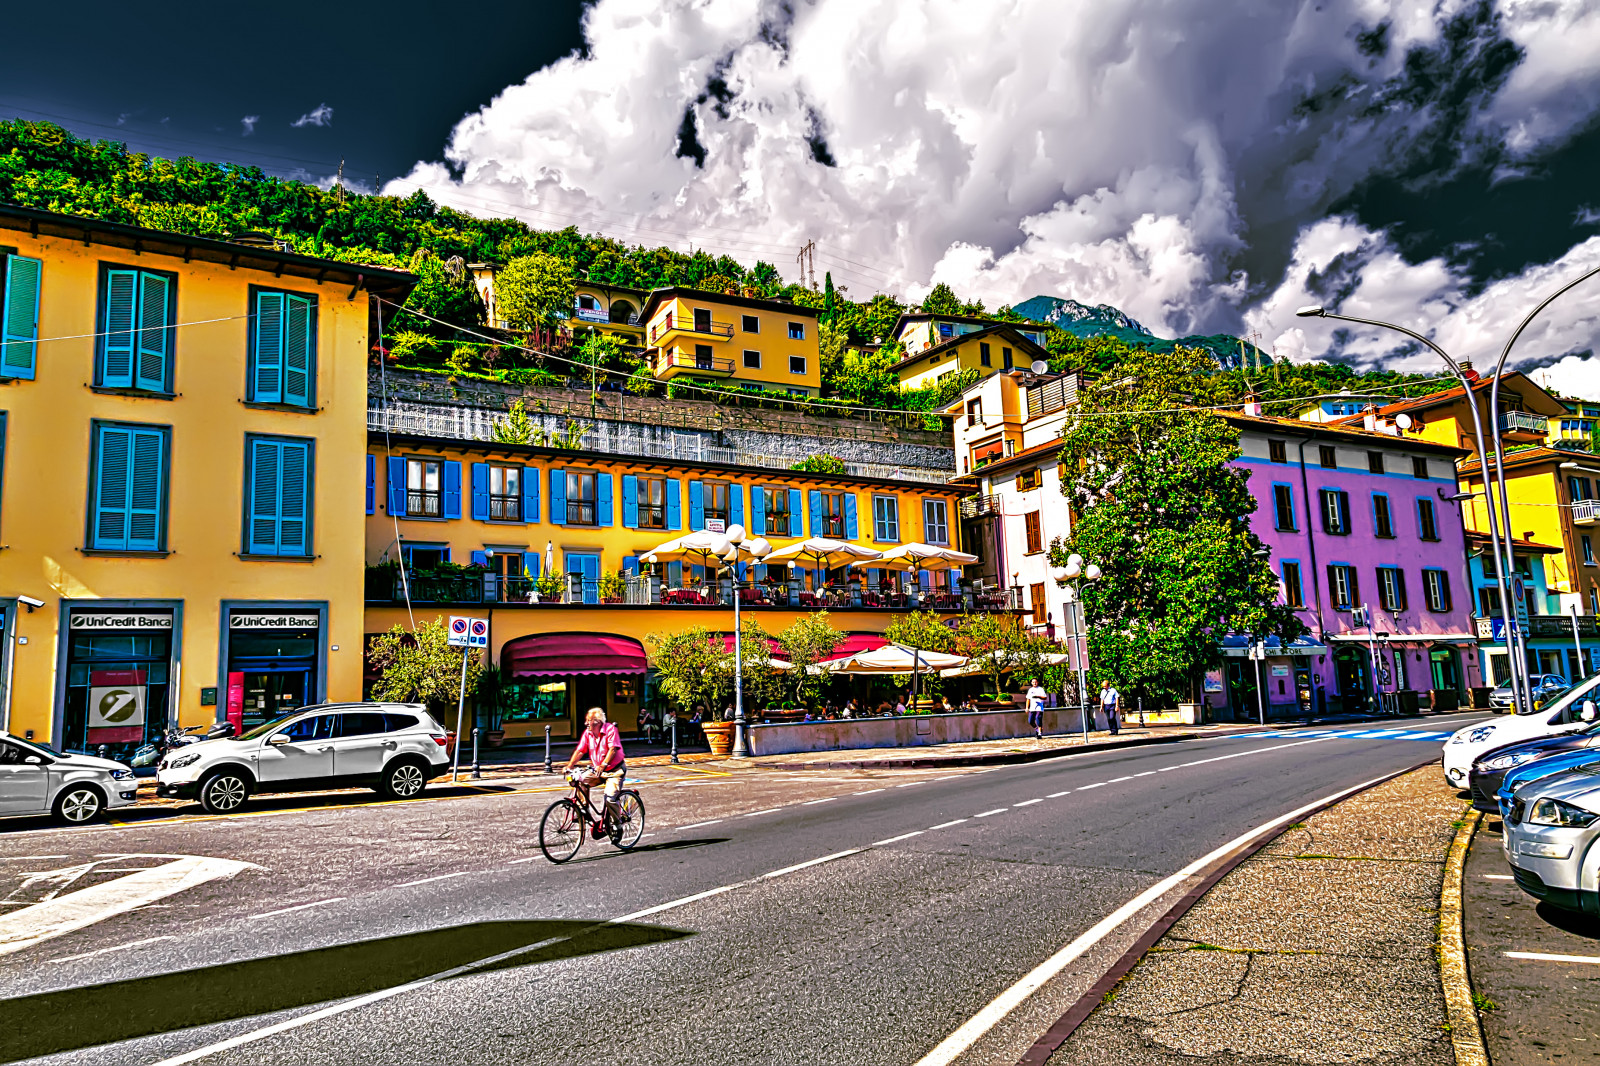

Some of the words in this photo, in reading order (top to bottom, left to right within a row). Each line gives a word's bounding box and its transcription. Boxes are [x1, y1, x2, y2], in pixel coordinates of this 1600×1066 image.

[86, 616, 136, 627] UniCredit
[138, 616, 171, 627] Banca
[243, 616, 287, 626] UniCredit
[289, 616, 317, 626] Banca
